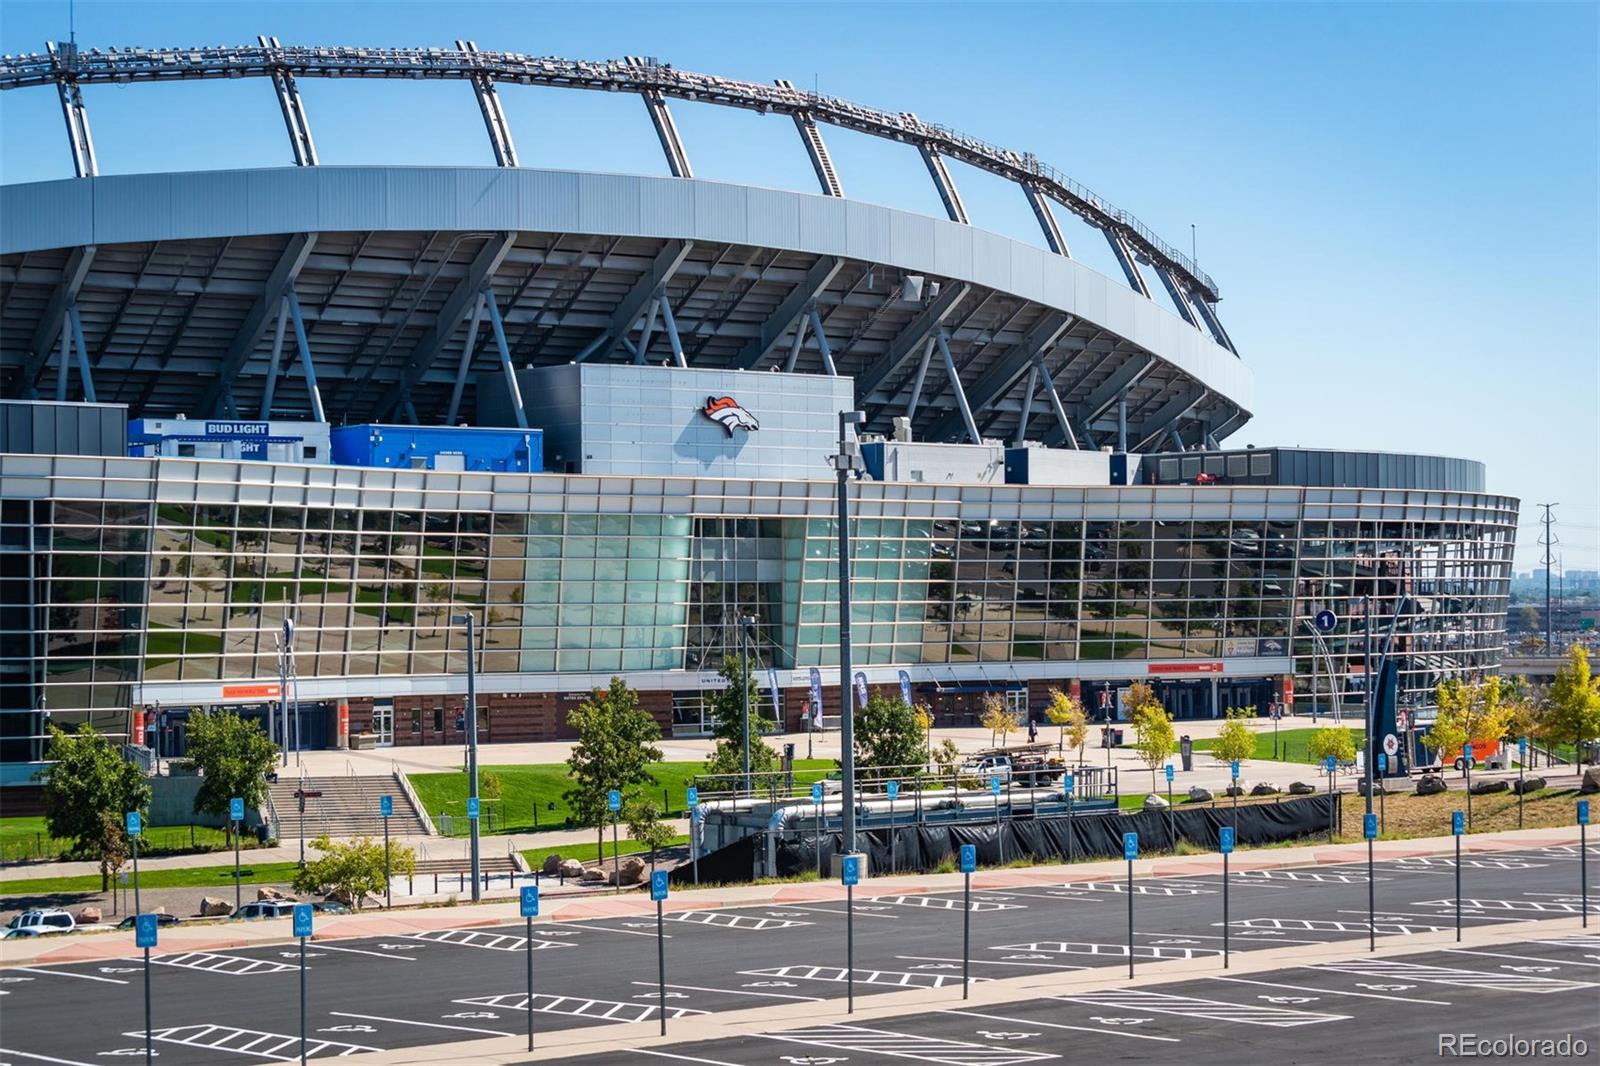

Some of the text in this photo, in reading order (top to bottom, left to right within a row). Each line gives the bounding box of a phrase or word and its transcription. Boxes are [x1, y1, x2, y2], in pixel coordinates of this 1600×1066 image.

[208, 424, 267, 434] BUD LIGHT
[240, 443, 260, 452] GHT
[1321, 615, 1329, 627] 1
